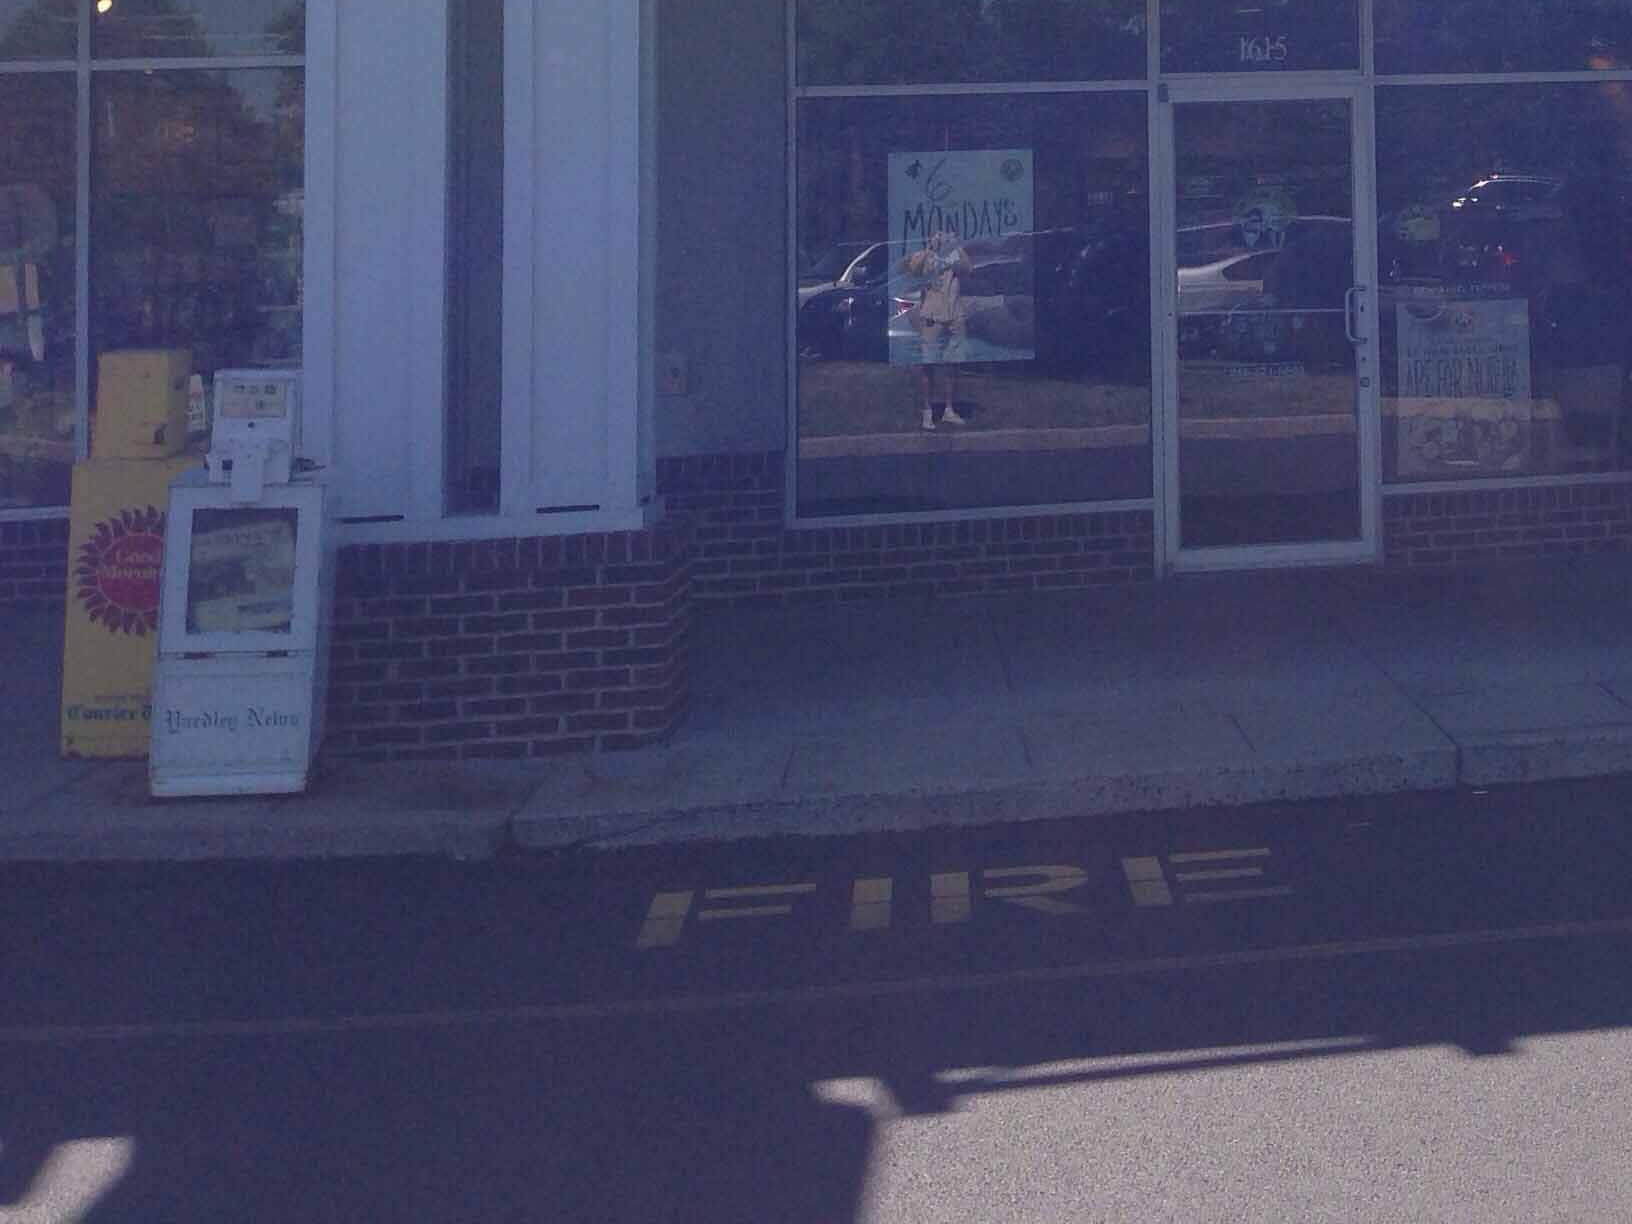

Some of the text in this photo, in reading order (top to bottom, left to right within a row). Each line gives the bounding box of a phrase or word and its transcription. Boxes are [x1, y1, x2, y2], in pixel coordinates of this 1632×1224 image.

[902, 197, 1018, 252] MONDAYS
[164, 709, 239, 733] Yardley
[247, 706, 301, 728] News
[634, 847, 1295, 950] FIRE
